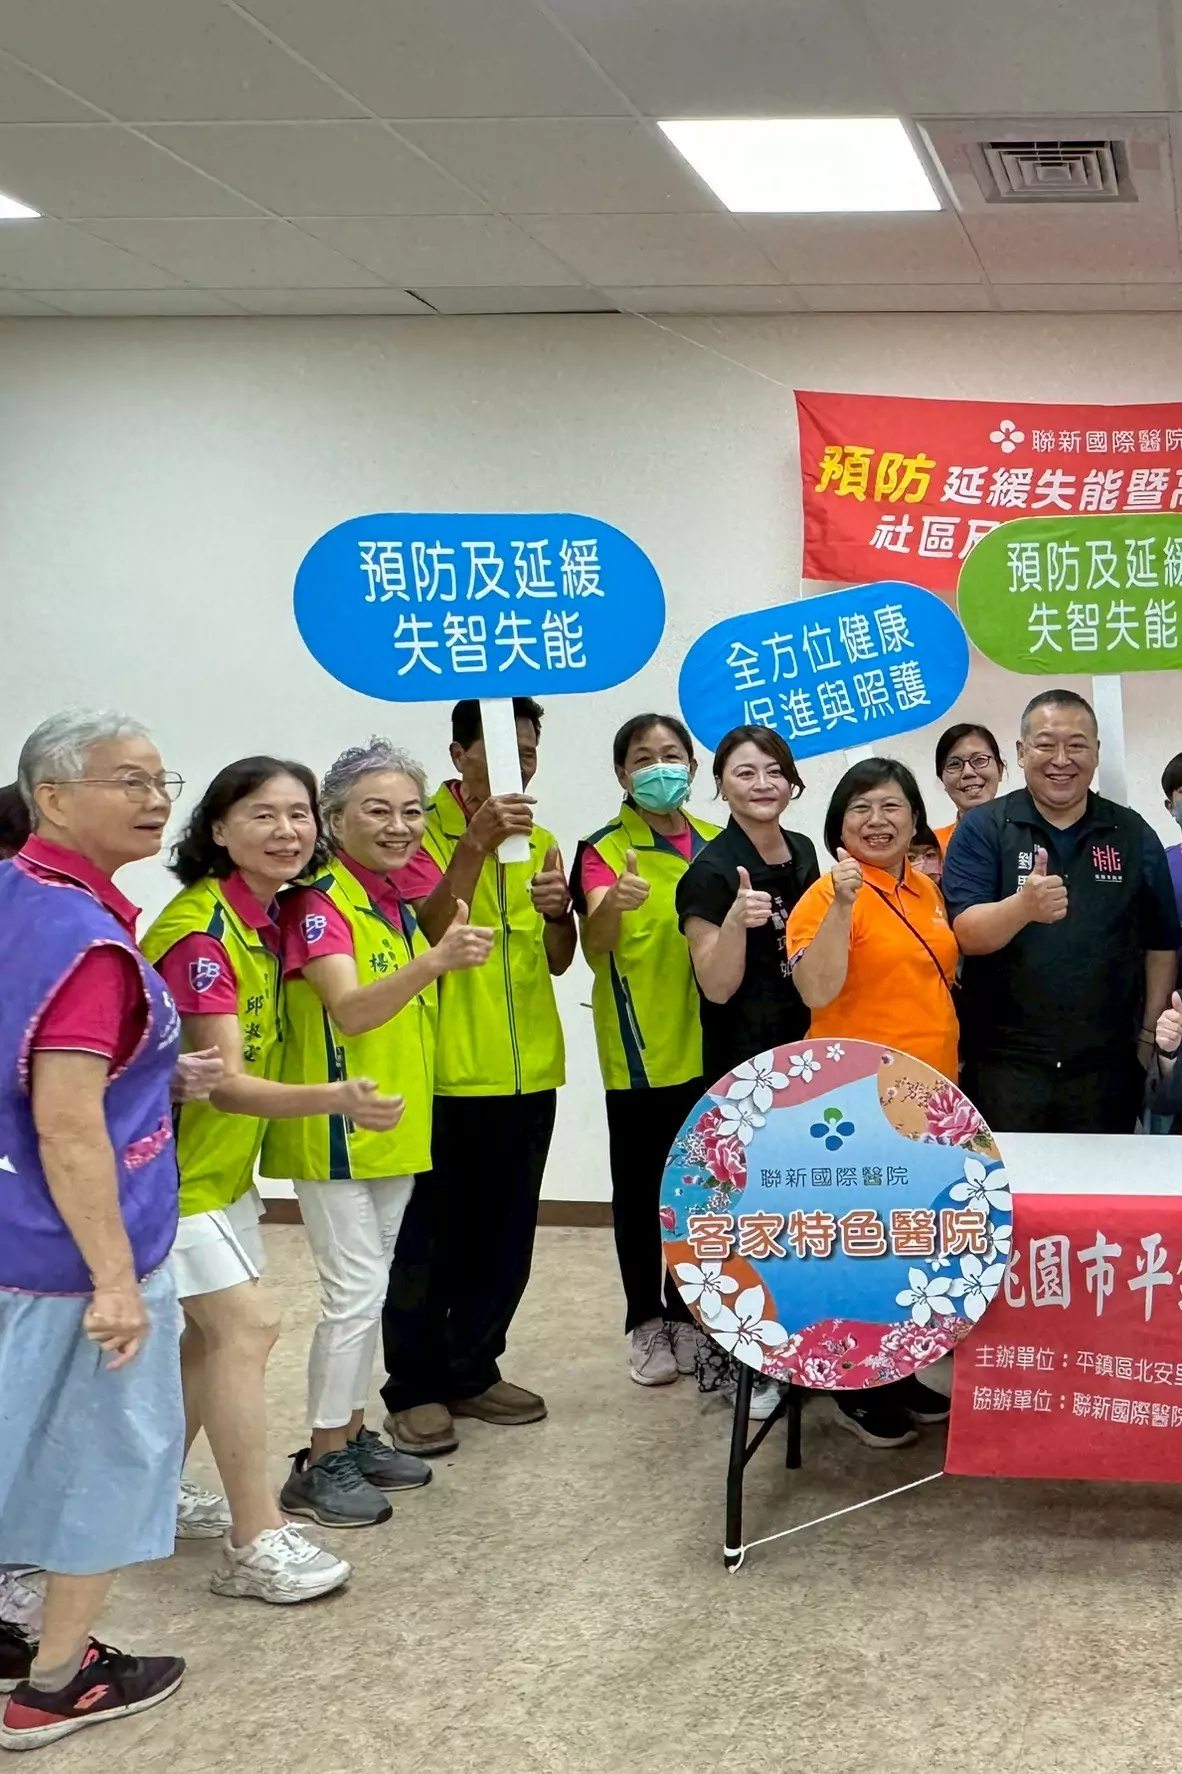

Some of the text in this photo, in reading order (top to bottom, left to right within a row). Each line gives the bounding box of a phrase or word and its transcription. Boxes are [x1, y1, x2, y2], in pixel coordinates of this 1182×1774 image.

[815, 445, 936, 504] 預防
[359, 538, 606, 603] 預防及延緩
[392, 610, 588, 677] 失智失能
[725, 603, 916, 692] 全方位健康
[1028, 597, 1179, 655] 失智失能
[742, 660, 932, 740] 促進與照護
[760, 1166, 909, 1188] 聯新國際醫院
[687, 1208, 989, 1260] 客家特色醫院
